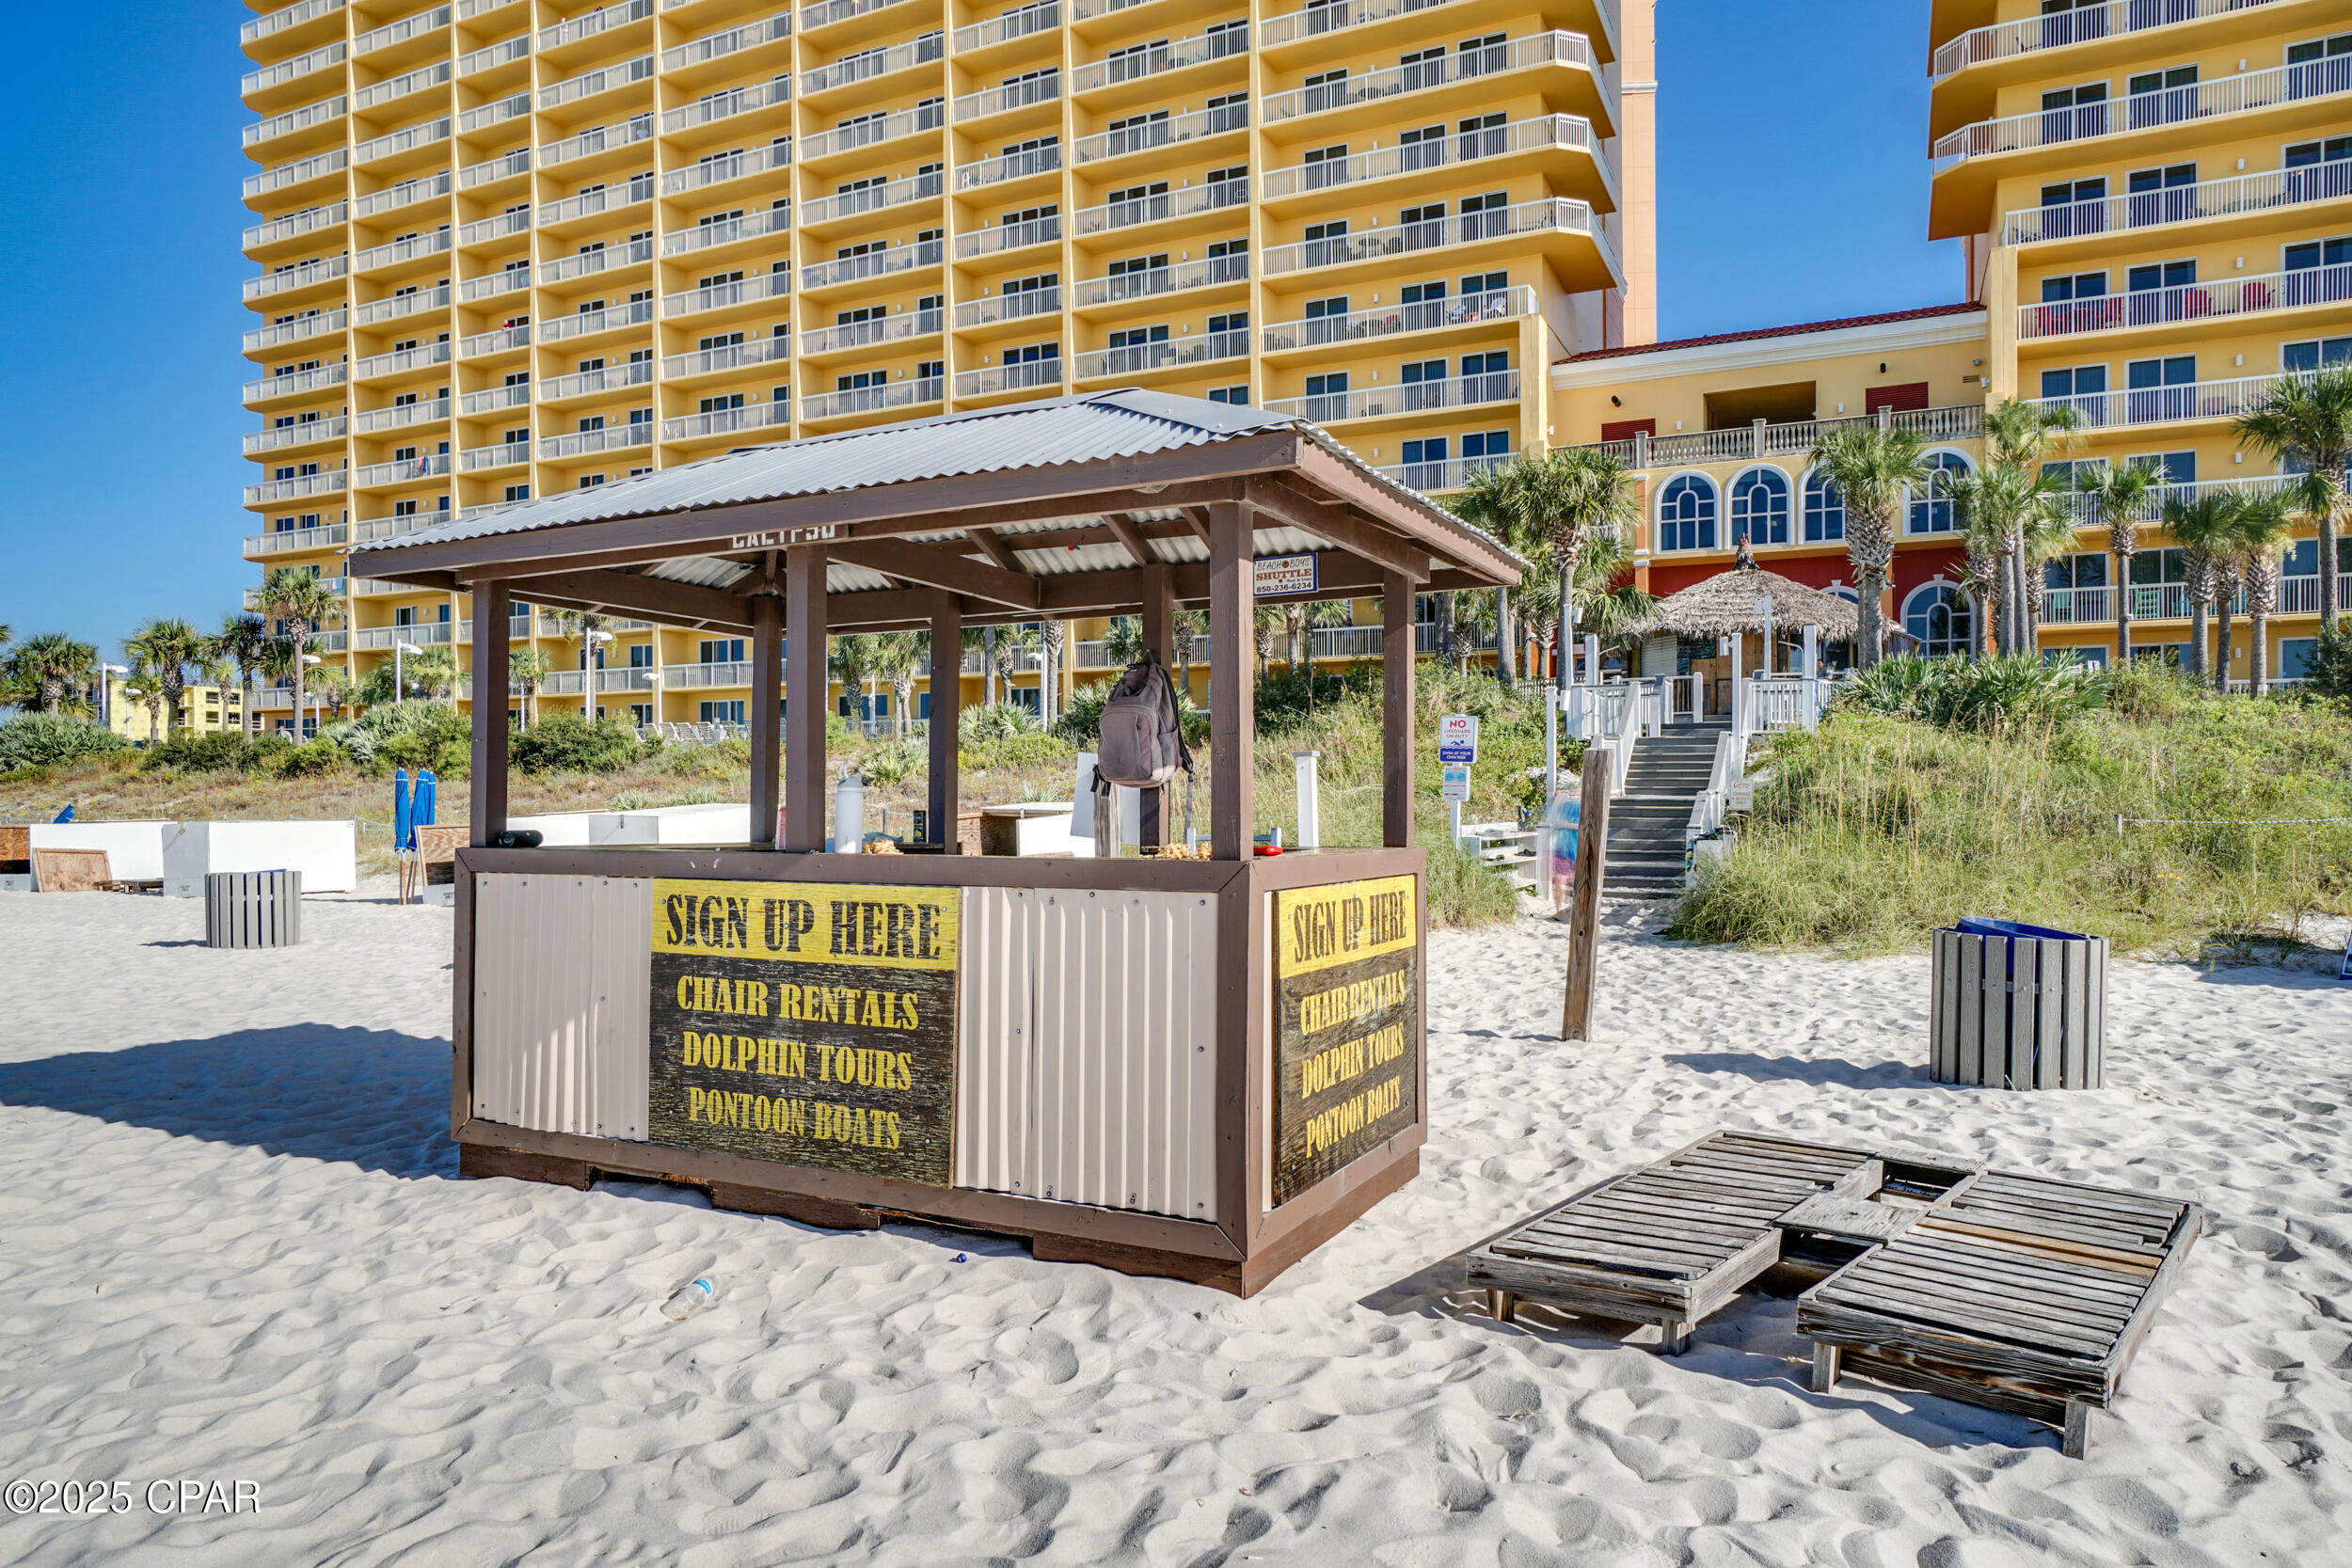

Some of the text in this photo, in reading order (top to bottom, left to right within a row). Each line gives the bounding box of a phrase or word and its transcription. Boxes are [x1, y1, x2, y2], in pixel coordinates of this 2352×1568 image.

[1256, 569, 1311, 581] SHUTTLE
[1256, 582, 1311, 594] 850-236-6234
[1257, 560, 1281, 572] BEACH
[1450, 720, 1467, 728] NO
[666, 894, 941, 960] SIGN UP HERE
[1294, 891, 1406, 963] SIGN UP HERE
[676, 974, 919, 1031] CHAIR RENTALS
[682, 1031, 912, 1091] DOLPHIN TOURS
[1302, 1022, 1404, 1100] DOLPHIN TOURS
[689, 1086, 900, 1150] PONTOON BOATS
[1306, 1075, 1400, 1159] PONTOON BOATS
